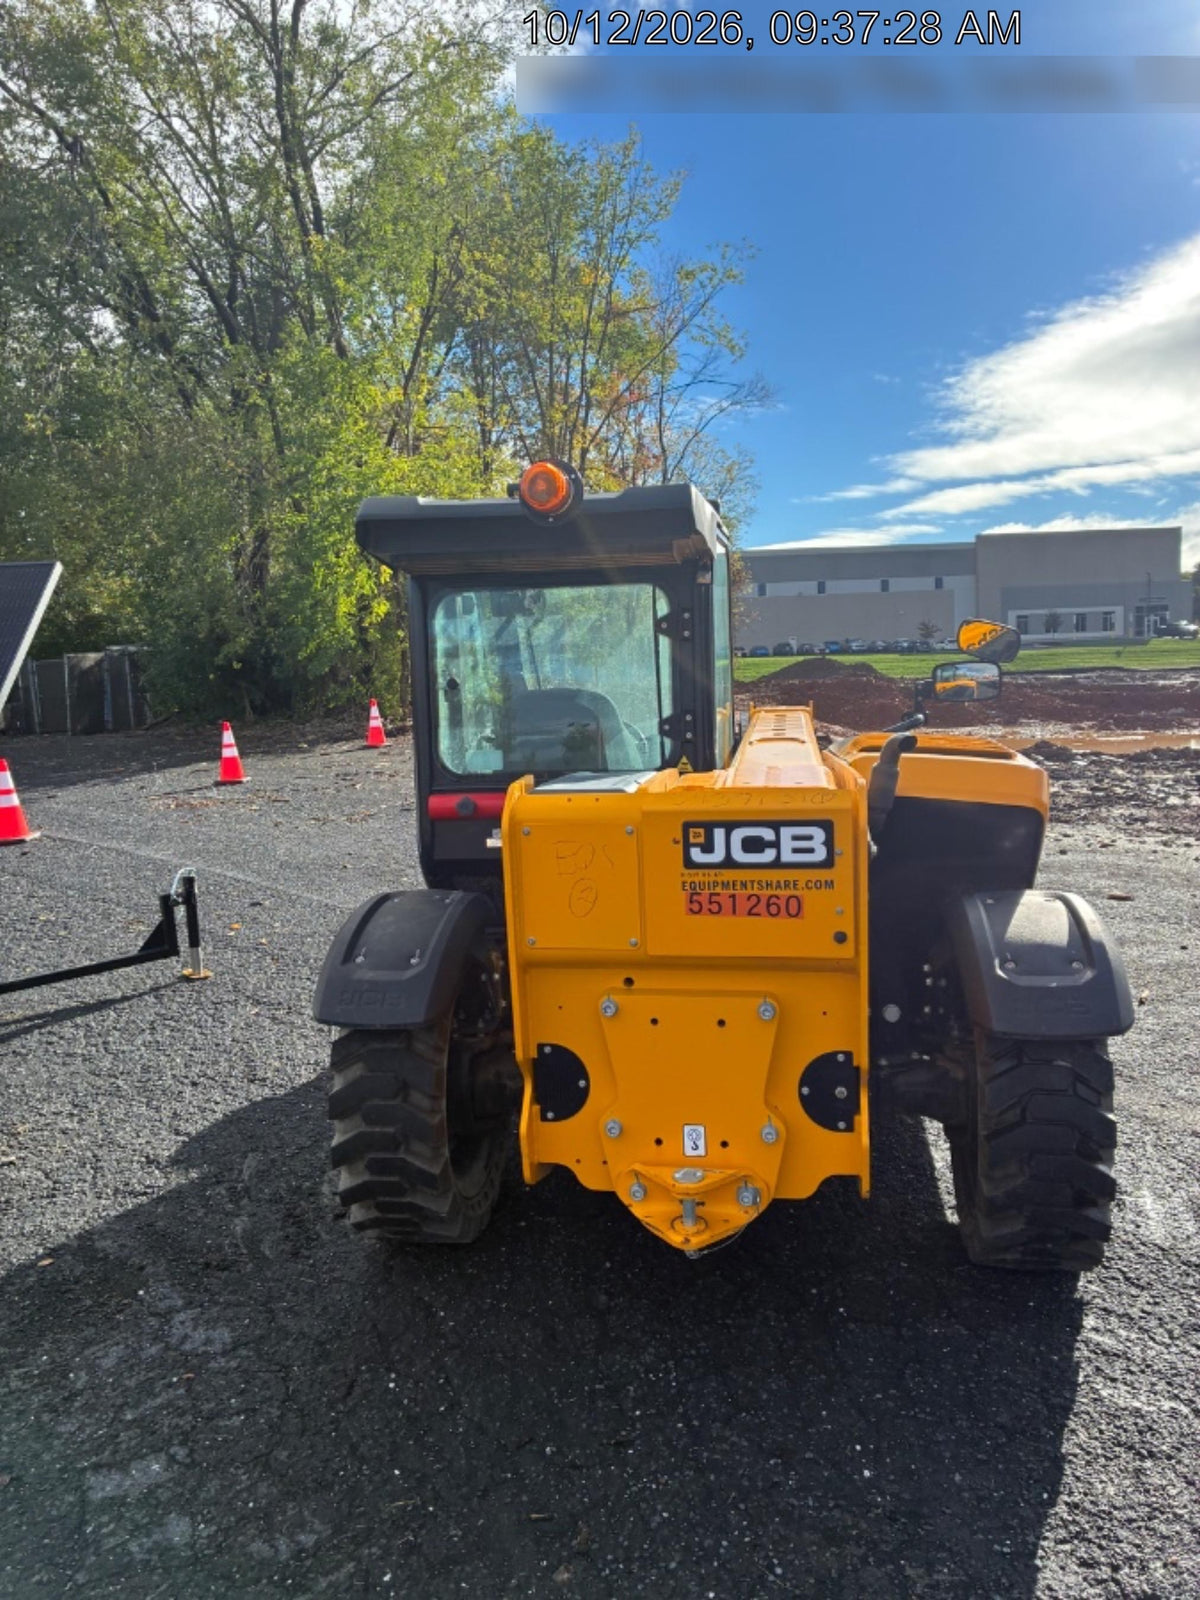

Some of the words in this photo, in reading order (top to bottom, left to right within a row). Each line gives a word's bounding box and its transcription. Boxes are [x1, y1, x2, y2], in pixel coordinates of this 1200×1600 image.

[689, 826, 828, 864] JCB
[681, 879, 835, 892] EQUIPMENTSHARE.COM
[688, 892, 802, 918] 551260
